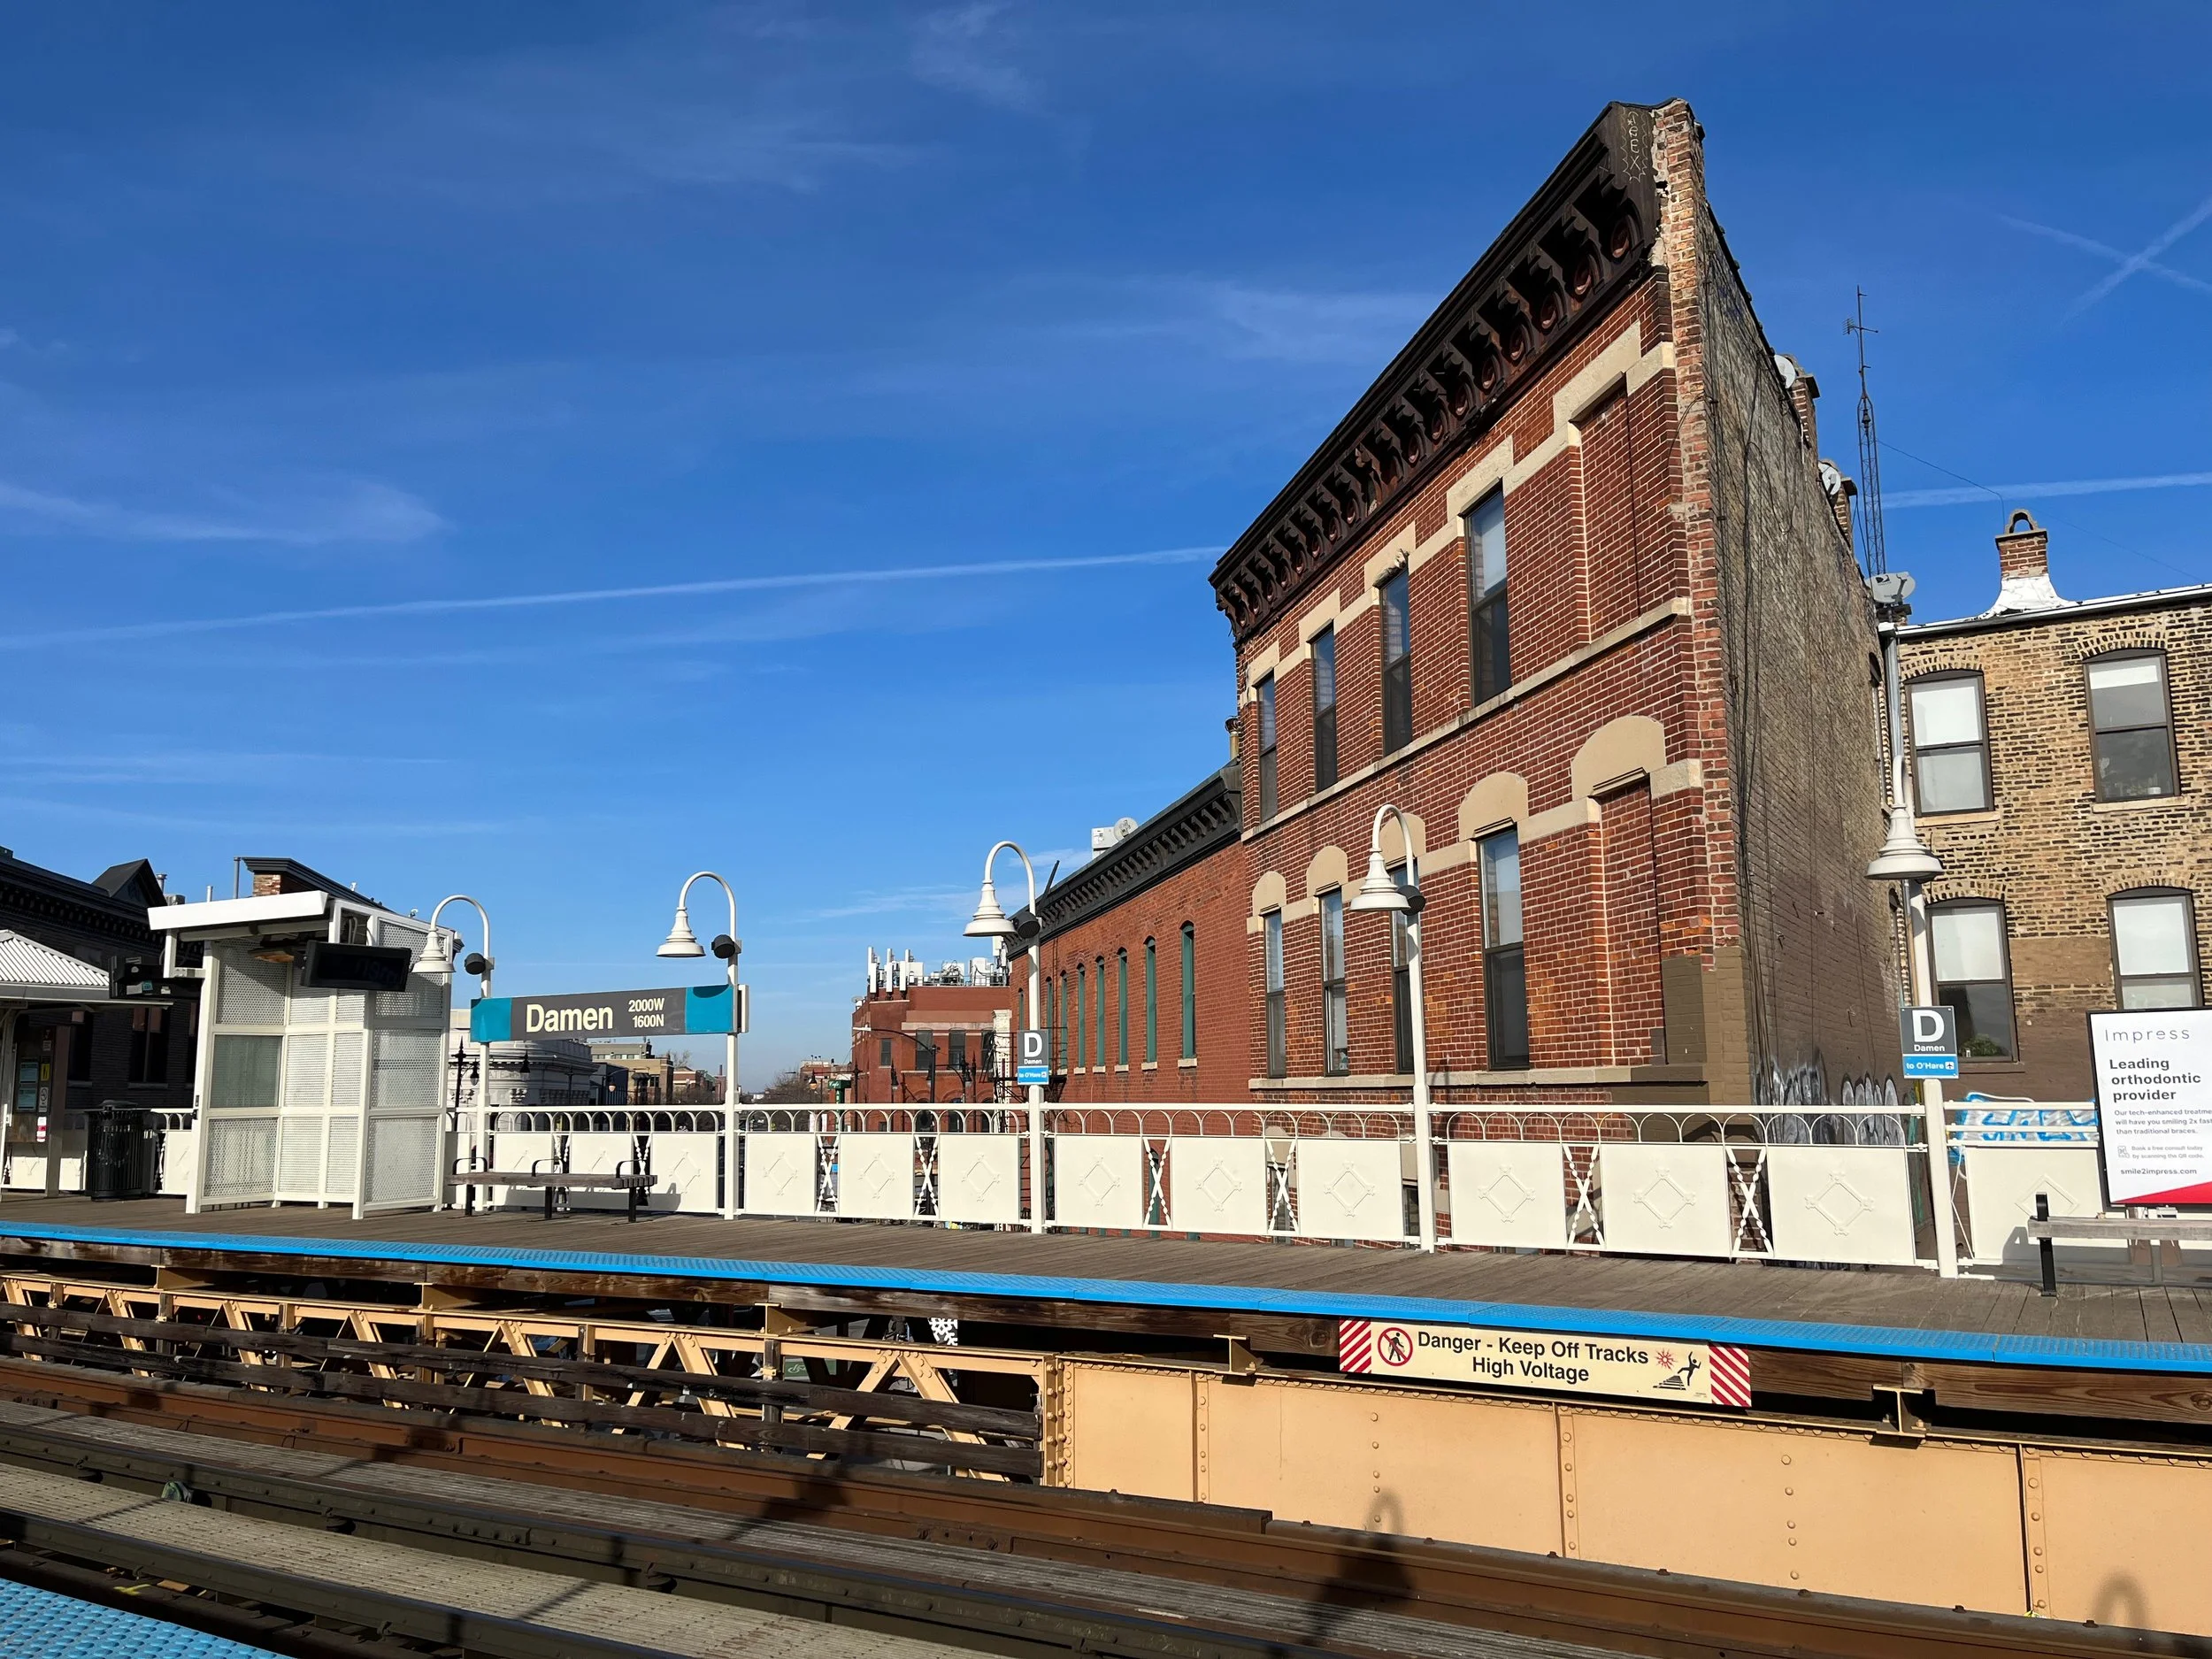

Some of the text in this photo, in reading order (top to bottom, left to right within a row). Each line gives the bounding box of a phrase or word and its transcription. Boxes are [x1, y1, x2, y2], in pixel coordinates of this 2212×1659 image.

[628, 997, 664, 1012] 2000W
[526, 1003, 613, 1033] Damen
[633, 1013, 664, 1028] 1600N
[1912, 1010, 1945, 1042] D
[2105, 1029, 2190, 1043] Impress
[1024, 1032, 1043, 1057] D
[2109, 1058, 2170, 1071] Leading
[2111, 1072, 2201, 1085] orthodontic
[2113, 1089, 2177, 1103] provider
[1417, 1331, 1482, 1354] Danger
[1499, 1337, 1546, 1360] Keep
[1551, 1340, 1580, 1359] Off
[1584, 1343, 1649, 1364] Tracks
[1472, 1356, 1590, 1385] High Voltage
